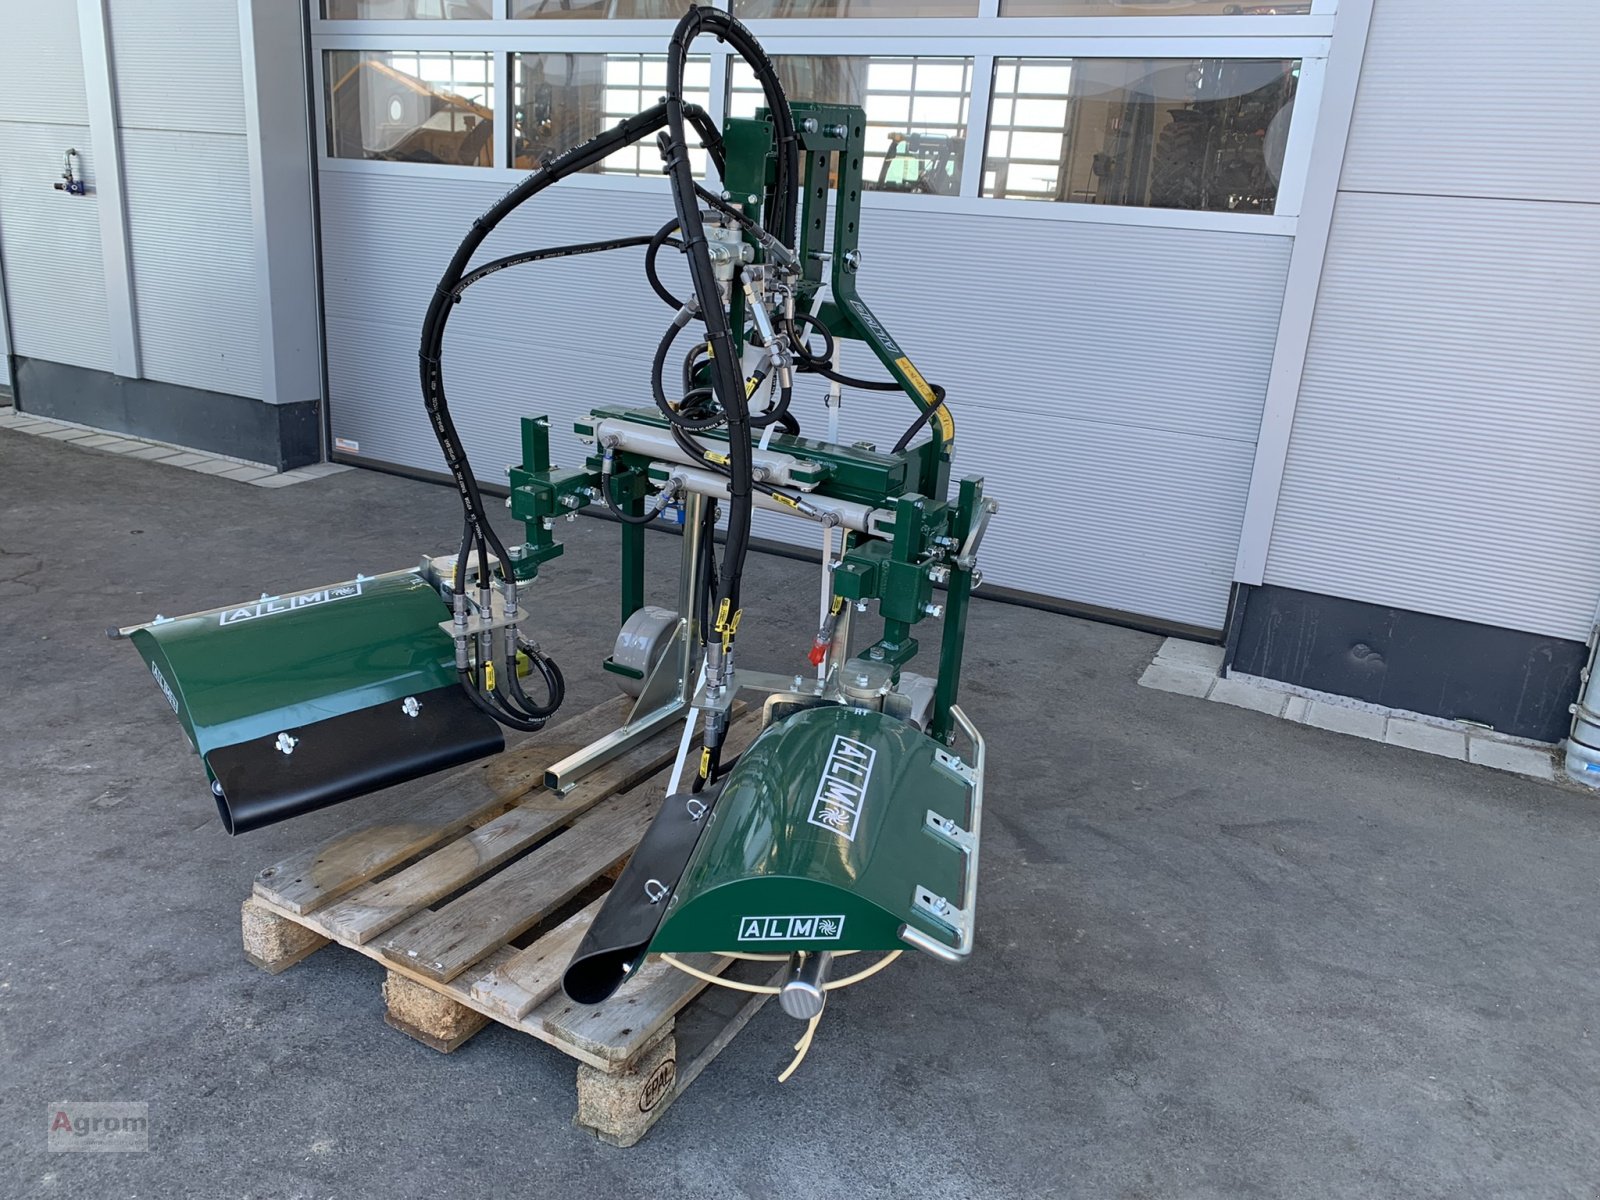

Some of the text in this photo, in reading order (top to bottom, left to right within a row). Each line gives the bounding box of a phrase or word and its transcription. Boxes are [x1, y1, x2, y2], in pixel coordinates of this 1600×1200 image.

[230, 594, 320, 620] ALM
[822, 741, 868, 808] ALM
[744, 920, 813, 937] ALM
[646, 1066, 671, 1107] EPAL
